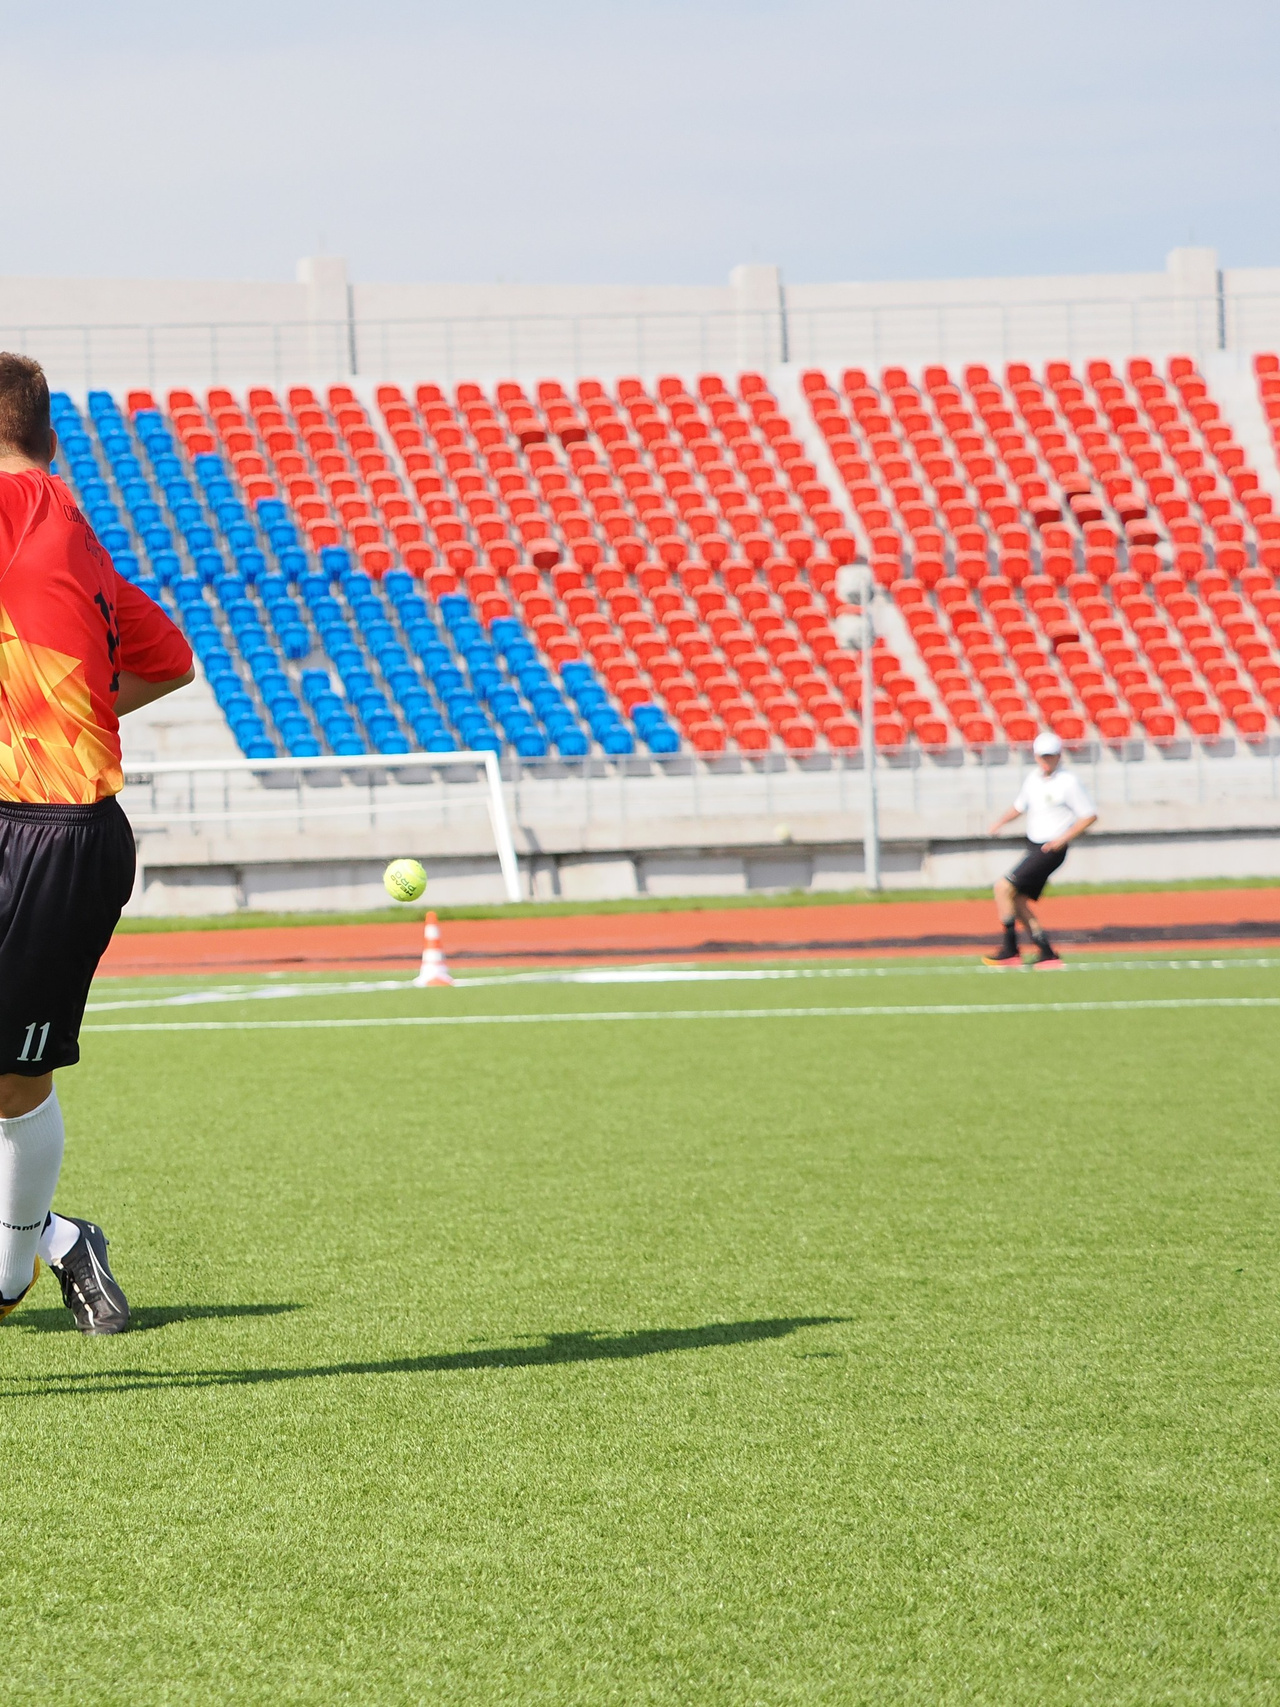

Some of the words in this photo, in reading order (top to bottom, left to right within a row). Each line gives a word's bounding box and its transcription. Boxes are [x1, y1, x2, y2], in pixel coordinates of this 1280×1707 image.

[390, 874, 414, 897] HEAD
[394, 870, 418, 893] PRO
[16, 1021, 51, 1062] 11
